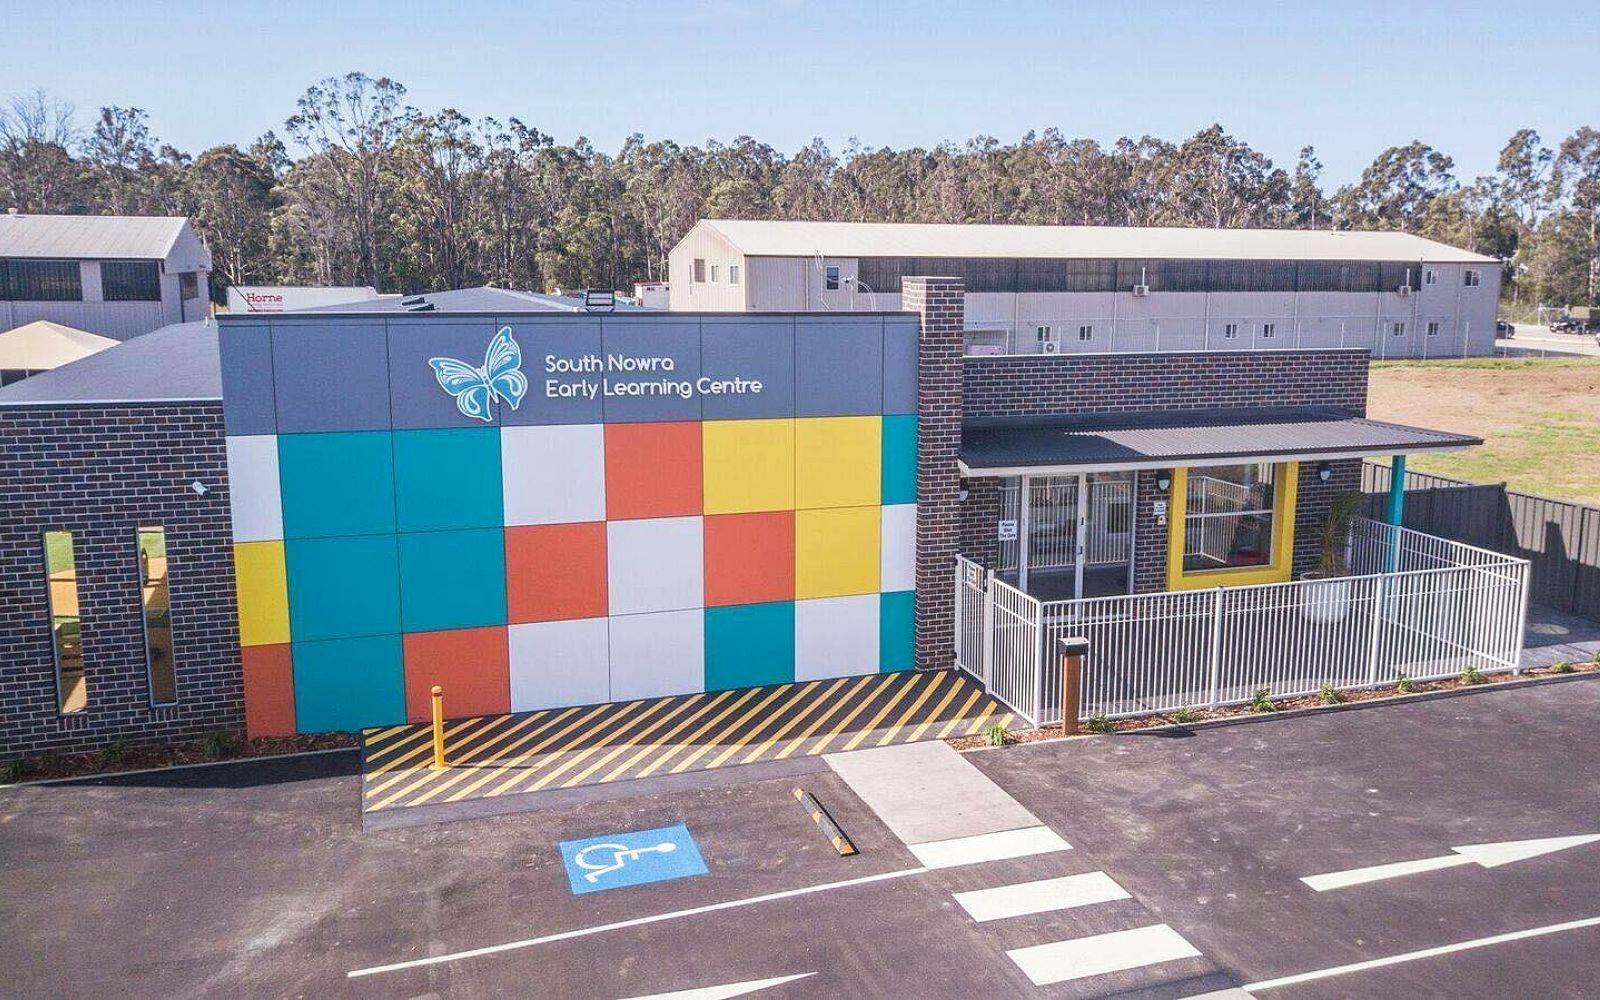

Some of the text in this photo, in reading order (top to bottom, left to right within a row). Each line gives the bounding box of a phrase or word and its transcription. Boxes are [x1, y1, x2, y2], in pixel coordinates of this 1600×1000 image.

[247, 293, 283, 302] Horne
[545, 354, 674, 372] South Nowra
[546, 376, 763, 400] Early Learning Centre
